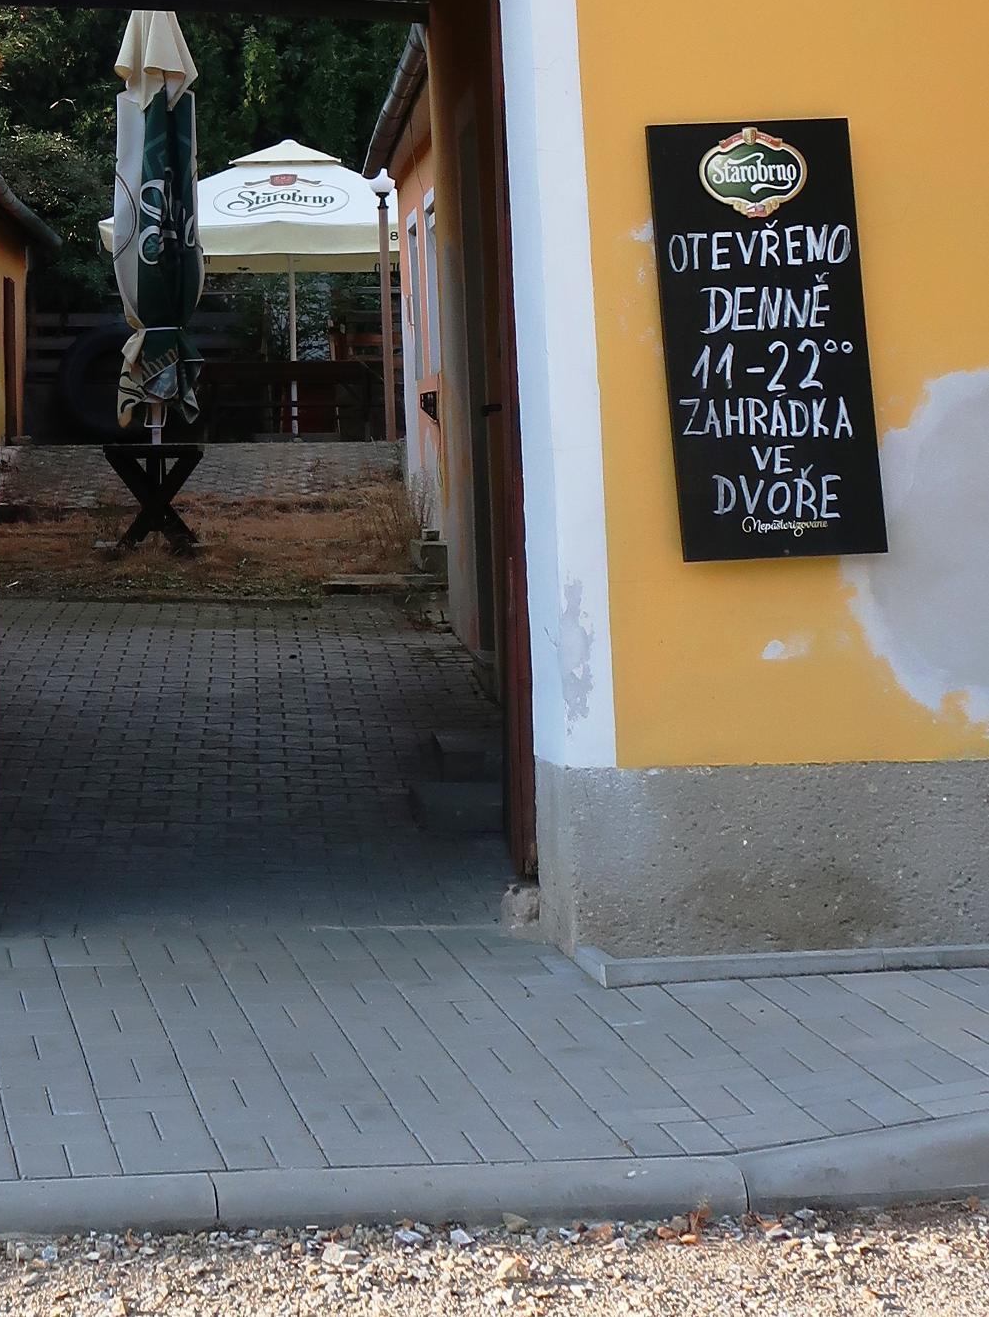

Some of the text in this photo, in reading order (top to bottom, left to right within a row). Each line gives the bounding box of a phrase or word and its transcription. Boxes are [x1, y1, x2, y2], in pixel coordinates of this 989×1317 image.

[712, 152, 797, 194] Starobrno
[227, 189, 335, 213] Starobrno
[668, 219, 852, 273] OTEVŘENO
[699, 272, 831, 334] DENNĚ
[678, 393, 854, 439] ZAHRÁDKA
[751, 445, 795, 474] VE
[712, 463, 842, 520] DVOŘE
